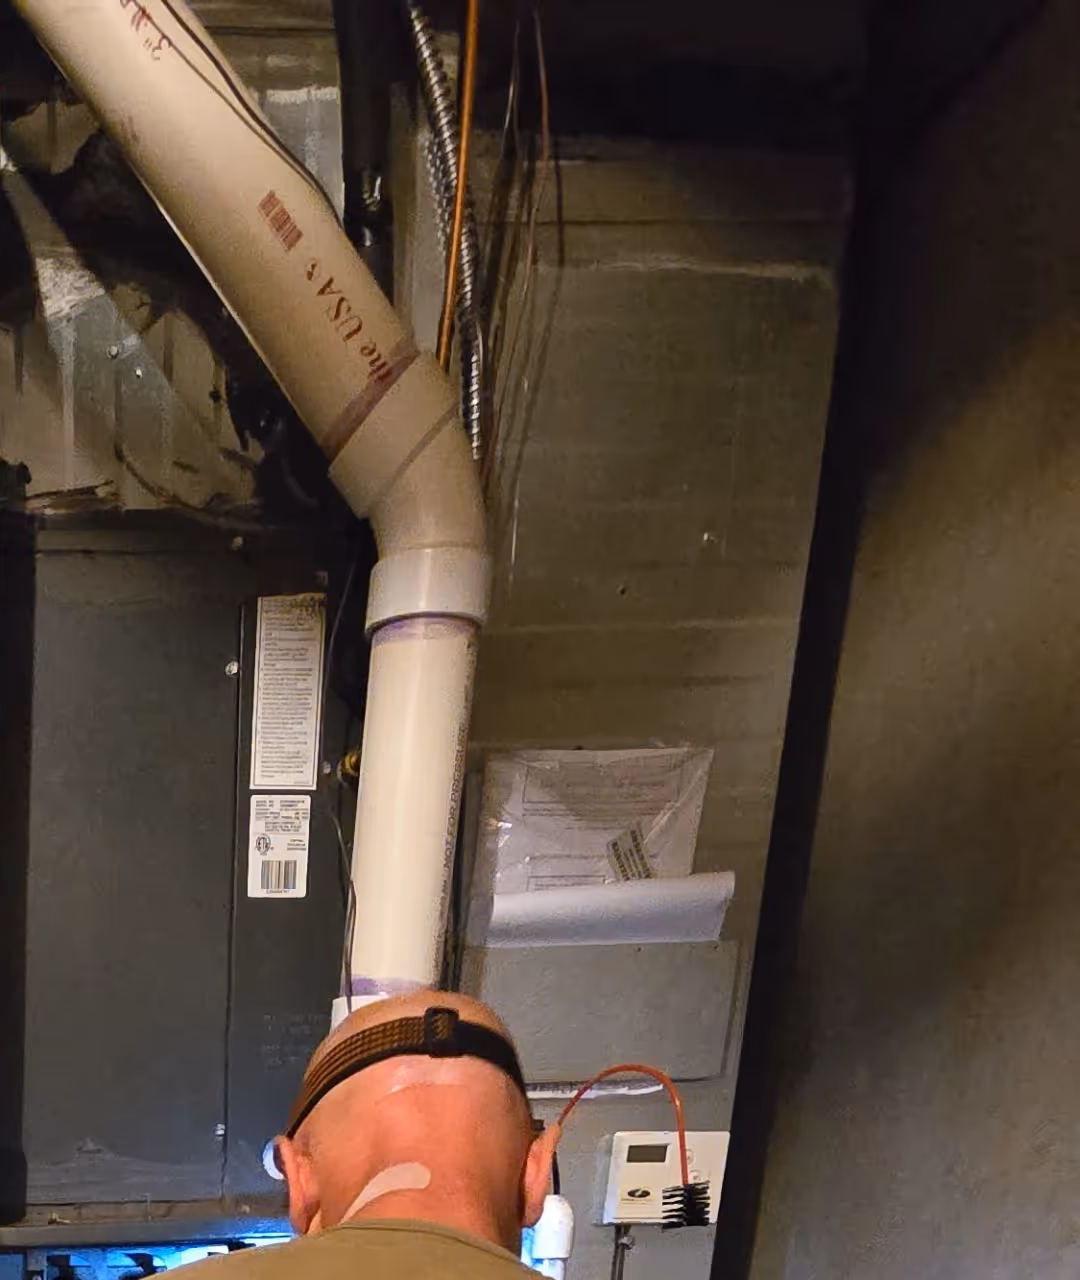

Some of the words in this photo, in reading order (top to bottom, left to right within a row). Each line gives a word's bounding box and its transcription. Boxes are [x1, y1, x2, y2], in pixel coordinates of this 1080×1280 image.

[316, 276, 363, 342] USA
[359, 340, 394, 382] the
[447, 806, 458, 838] FOR
